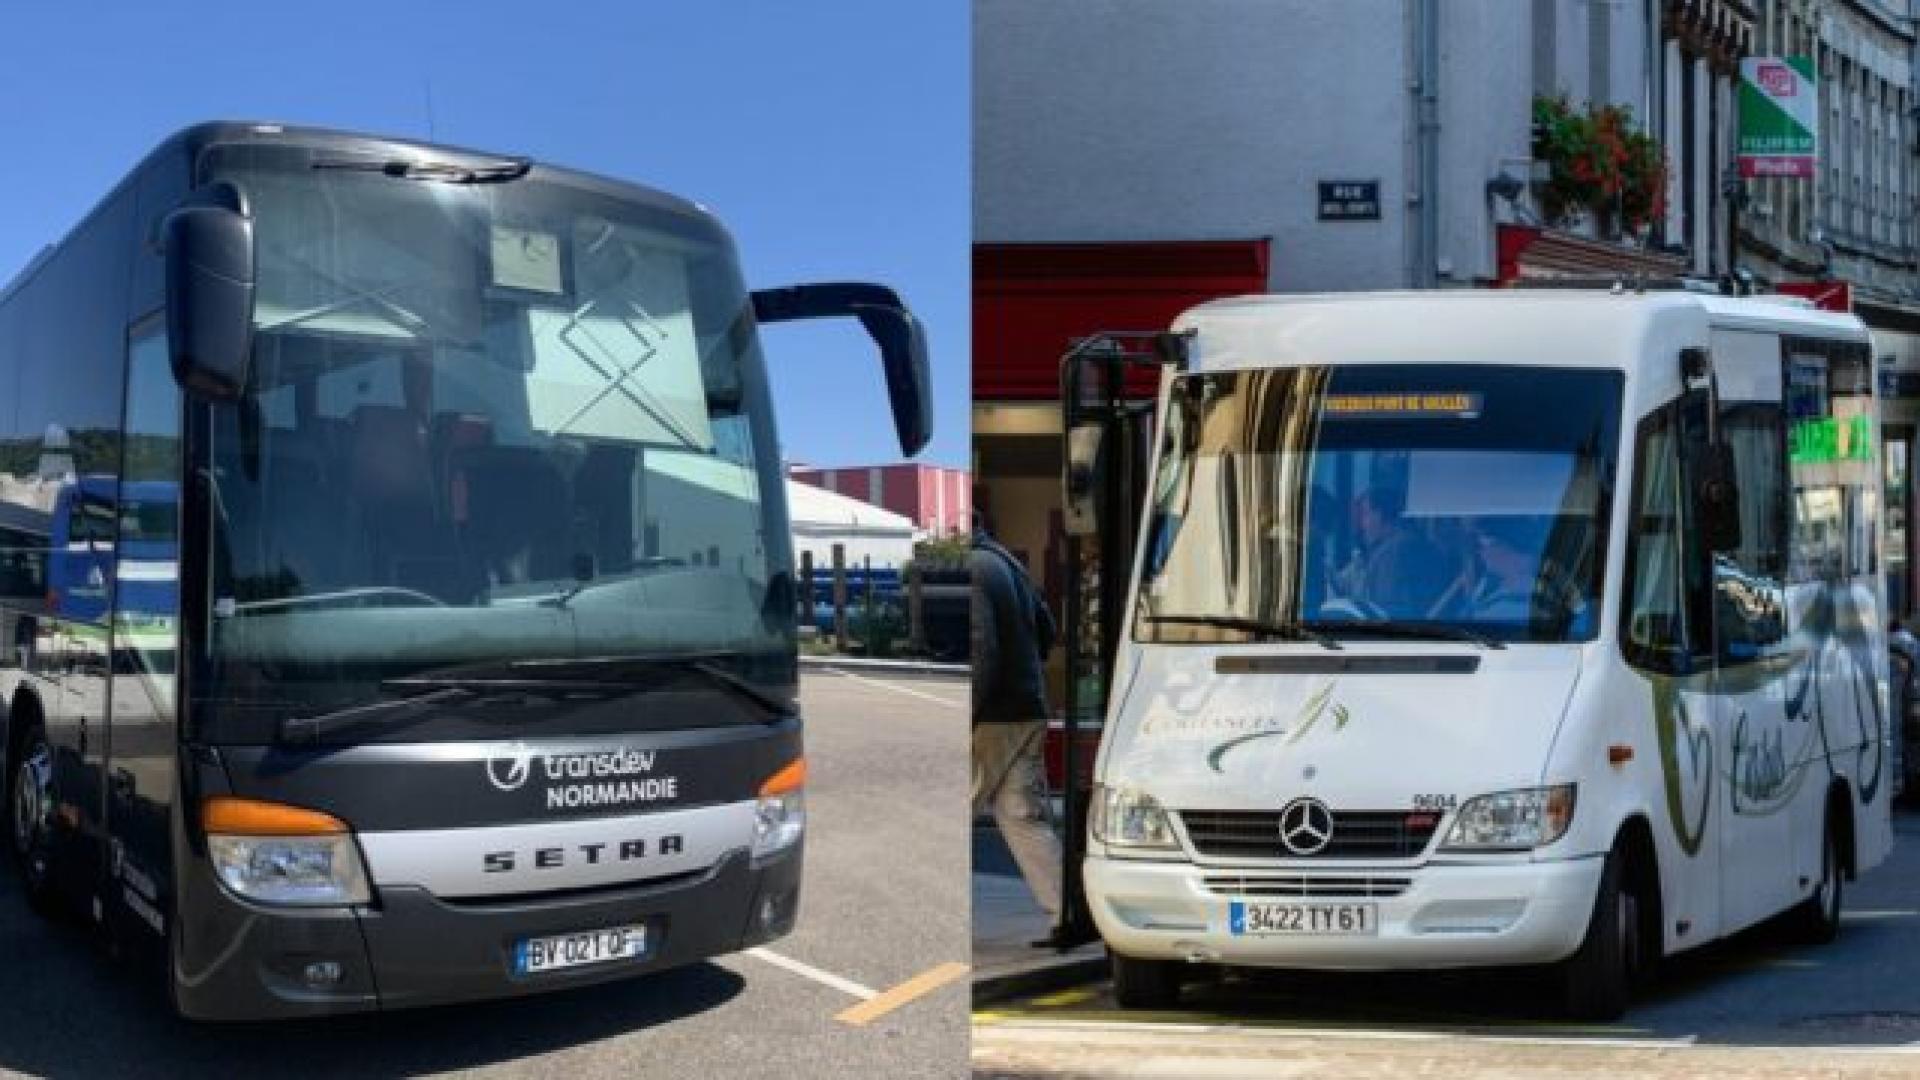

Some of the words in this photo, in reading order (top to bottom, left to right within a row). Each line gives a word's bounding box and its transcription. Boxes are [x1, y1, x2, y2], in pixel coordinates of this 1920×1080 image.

[544, 746, 656, 779] transdev
[546, 776, 678, 809] NORMANDIE
[482, 833, 684, 873] SETRA
[1247, 904, 1304, 931] 3422
[1338, 904, 1366, 931] 61
